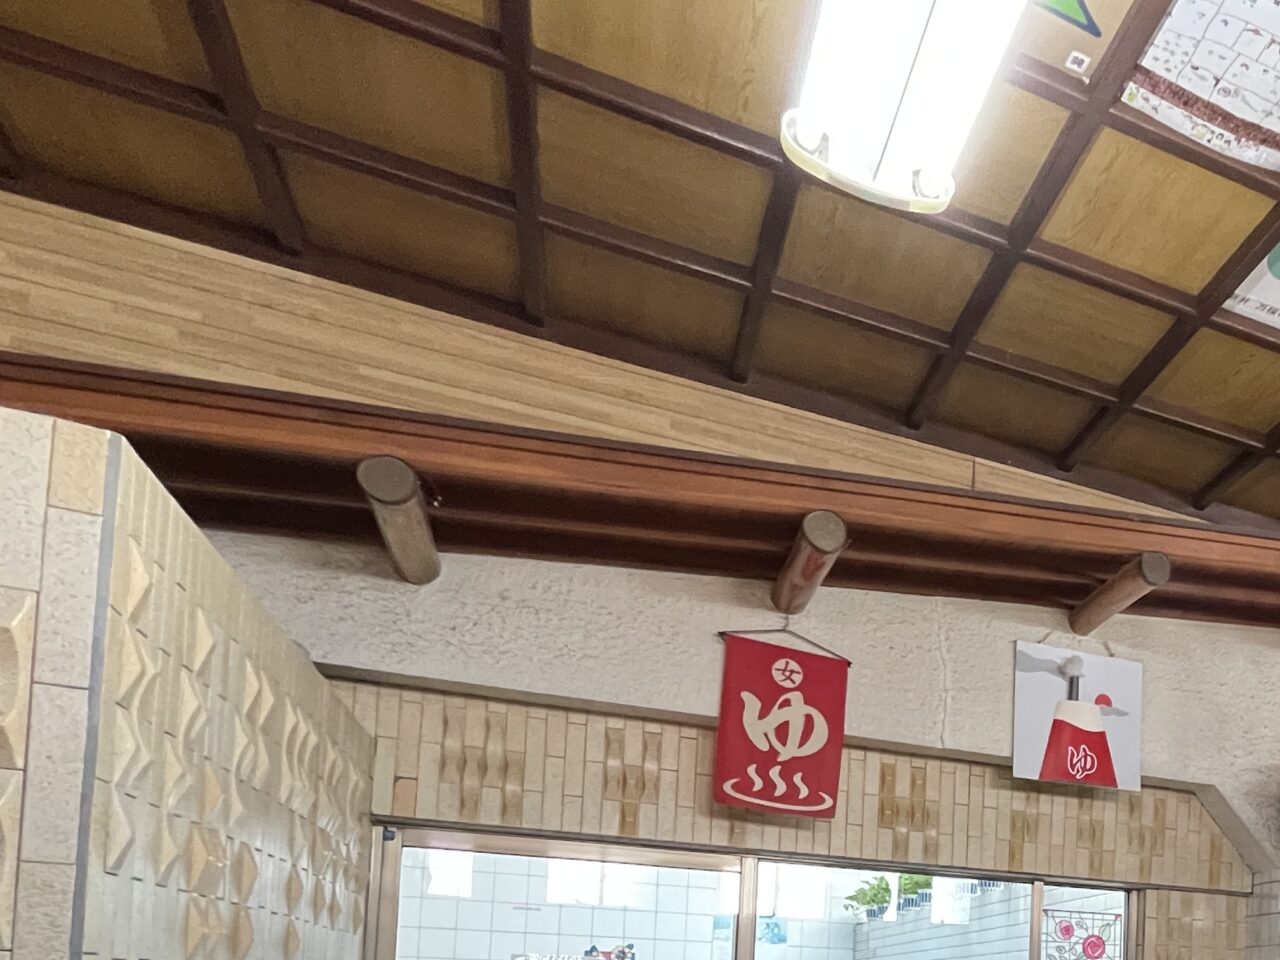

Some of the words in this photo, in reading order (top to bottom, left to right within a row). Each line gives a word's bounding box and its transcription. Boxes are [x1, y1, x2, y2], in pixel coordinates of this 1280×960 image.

[777, 661, 799, 685] 女
[741, 691, 828, 762] ゆ
[1067, 745, 1097, 779] ゆ
